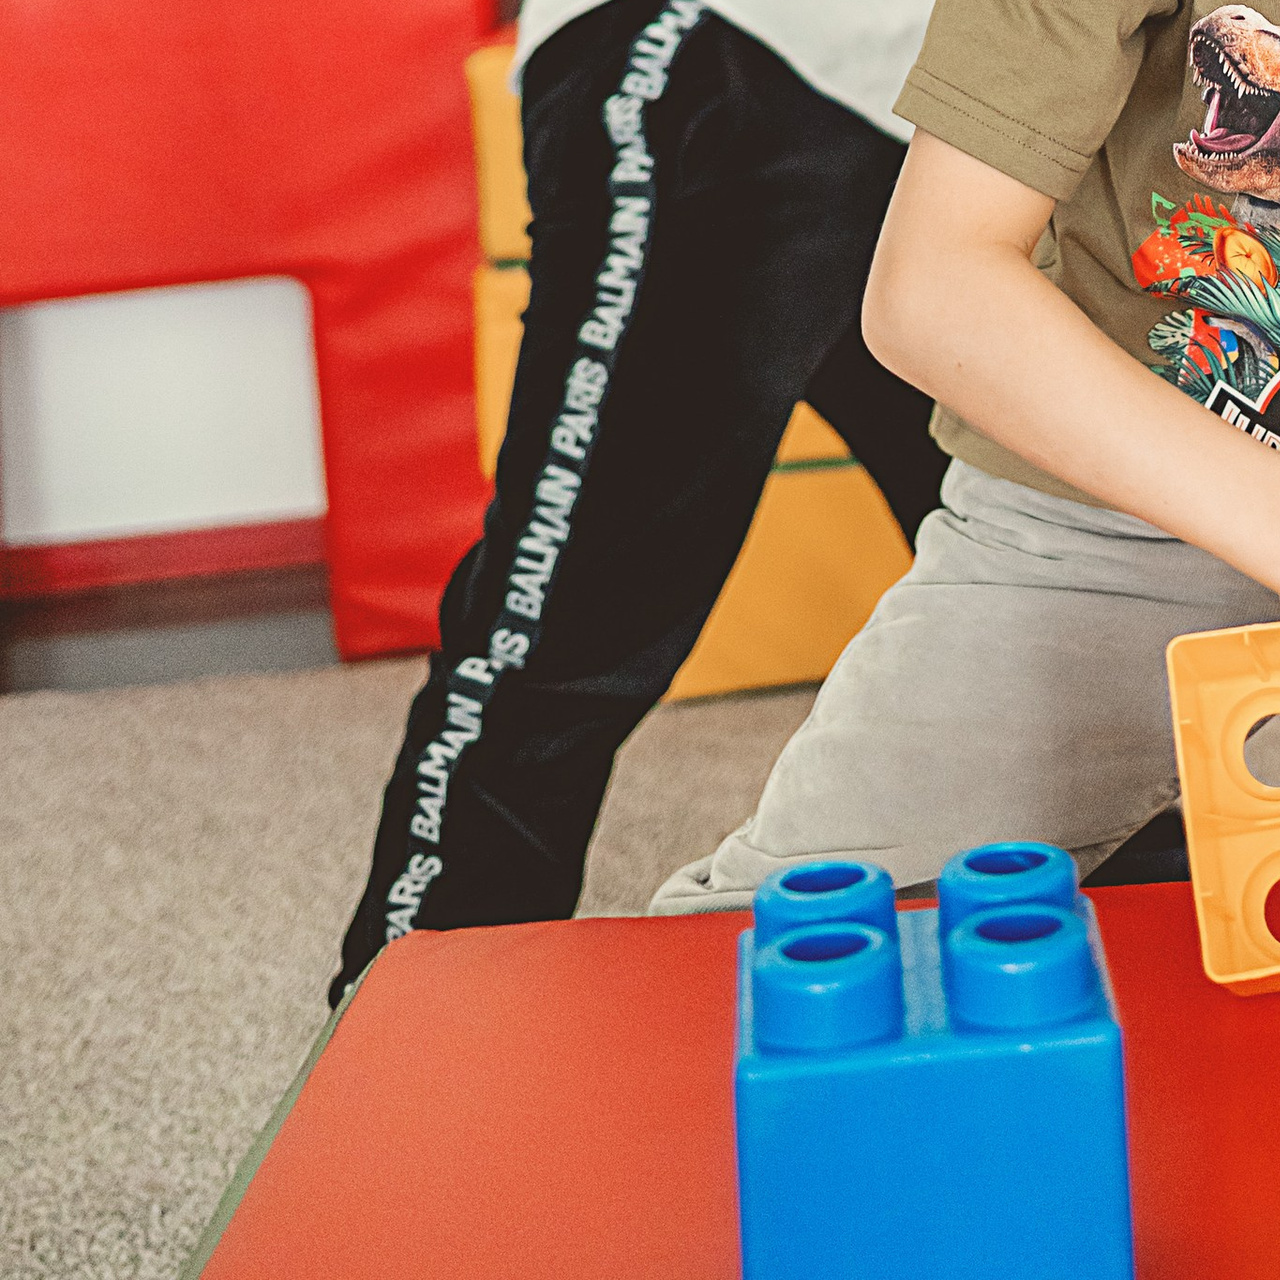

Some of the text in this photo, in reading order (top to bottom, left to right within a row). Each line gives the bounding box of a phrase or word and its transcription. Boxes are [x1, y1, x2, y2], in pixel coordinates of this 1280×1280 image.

[578, 196, 650, 350] BALMAIN
[551, 357, 609, 460] PARIS
[505, 463, 583, 620] BALMAIN
[411, 692, 483, 844] BALMAIN
